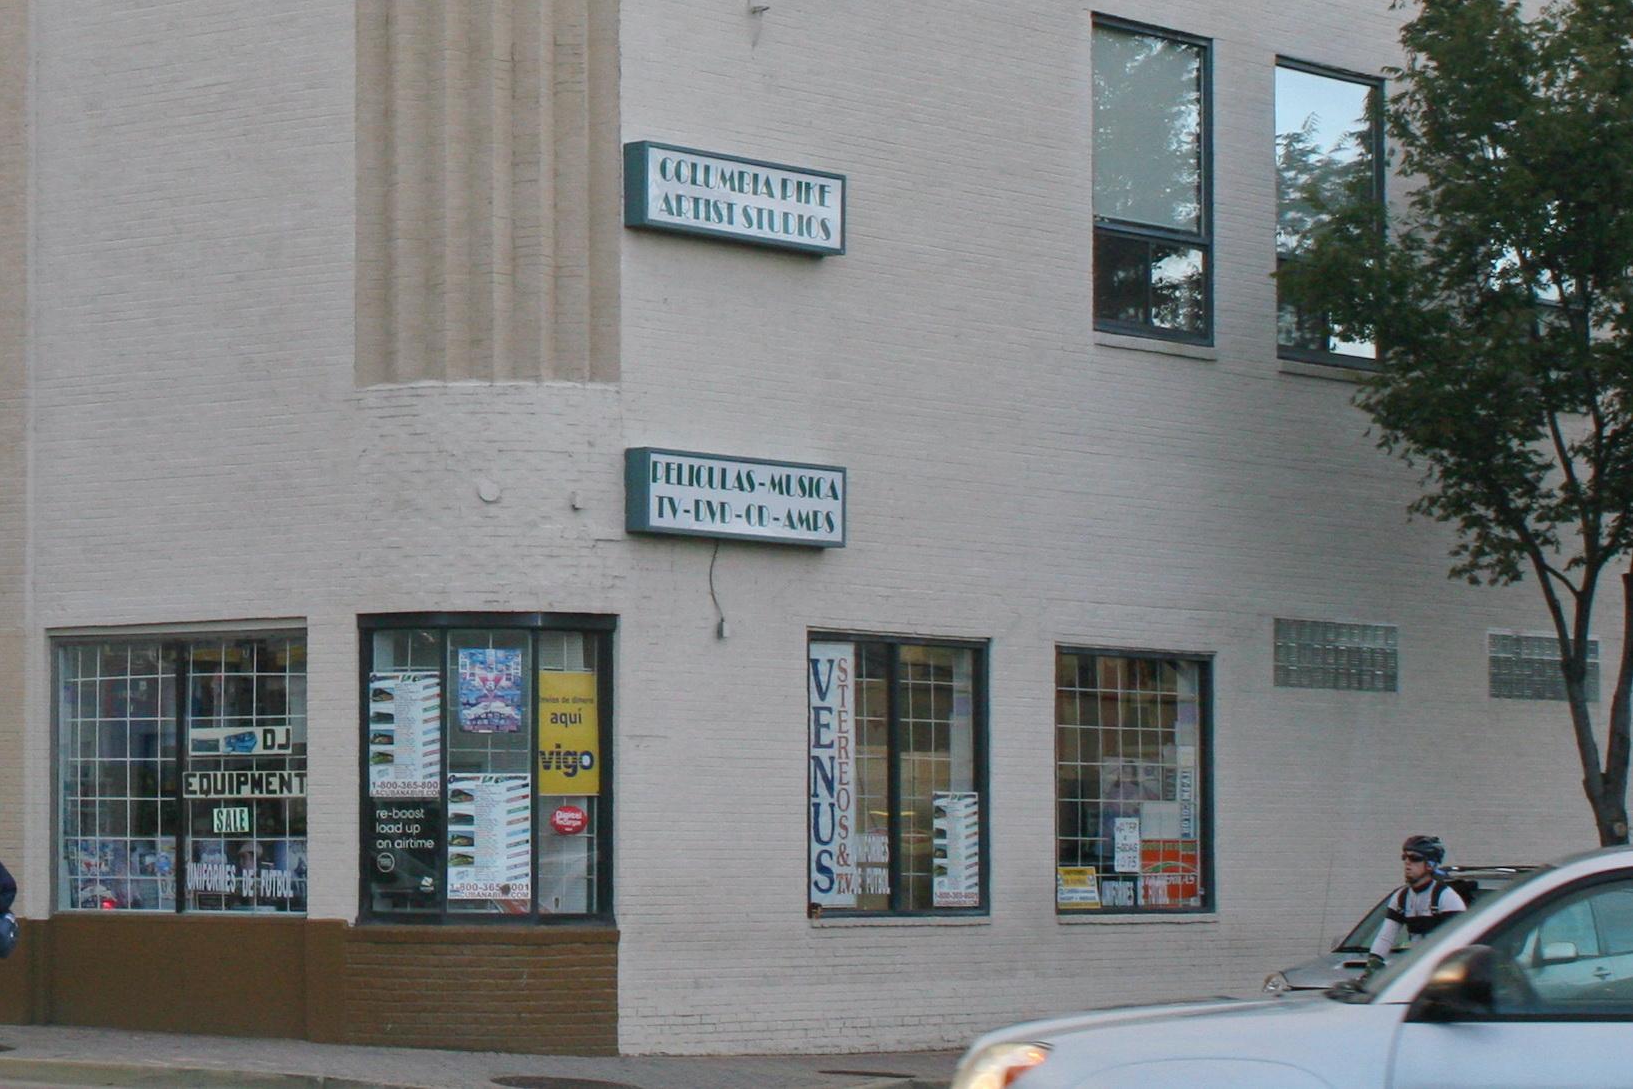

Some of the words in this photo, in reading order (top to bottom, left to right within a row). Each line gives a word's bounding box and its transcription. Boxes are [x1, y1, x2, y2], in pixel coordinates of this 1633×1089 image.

[660, 157, 775, 199] COLUMBIA
[781, 178, 832, 208] PIKE
[659, 192, 737, 226] ARTIST
[742, 204, 832, 241] STUDIOS
[550, 707, 583, 728] aquí
[262, 728, 291, 750] DJ
[539, 742, 595, 778] vigo
[183, 771, 307, 797] EQUIPMENT
[810, 658, 836, 894] VENUS
[216, 809, 246, 832] SALE
[376, 807, 424, 819] re-boost
[376, 822, 403, 833] load
[405, 824, 421, 835] up
[376, 839, 392, 849] on
[394, 837, 435, 849] airtime
[187, 862, 236, 893] UNIFORMES
[242, 870, 255, 897] DE
[260, 869, 294, 898] FUTBOL
